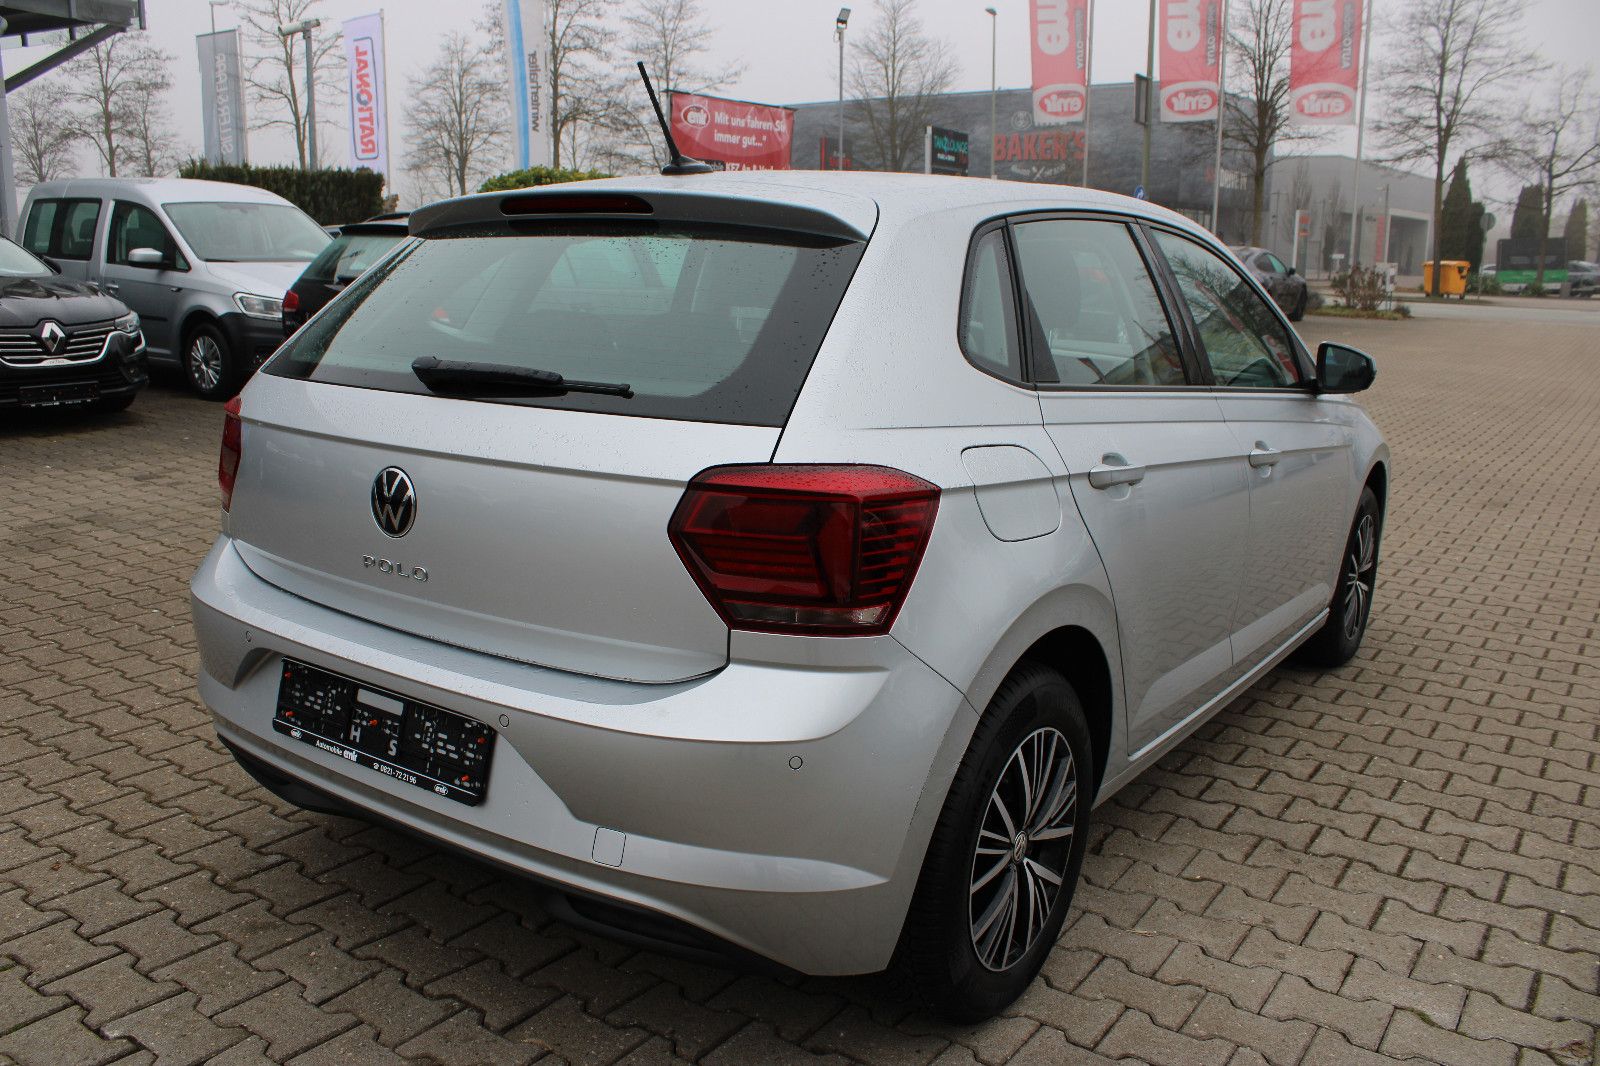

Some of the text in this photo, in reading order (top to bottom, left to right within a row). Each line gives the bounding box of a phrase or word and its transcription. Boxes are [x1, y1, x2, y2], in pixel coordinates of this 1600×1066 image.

[714, 111, 729, 125] Mit
[731, 116, 745, 128] uns
[747, 116, 773, 131] fahren
[714, 130, 740, 144] immer
[362, 553, 429, 582] POLO
[350, 724, 361, 744] H
[315, 740, 358, 762] Automobile emir
[387, 739, 399, 757] S
